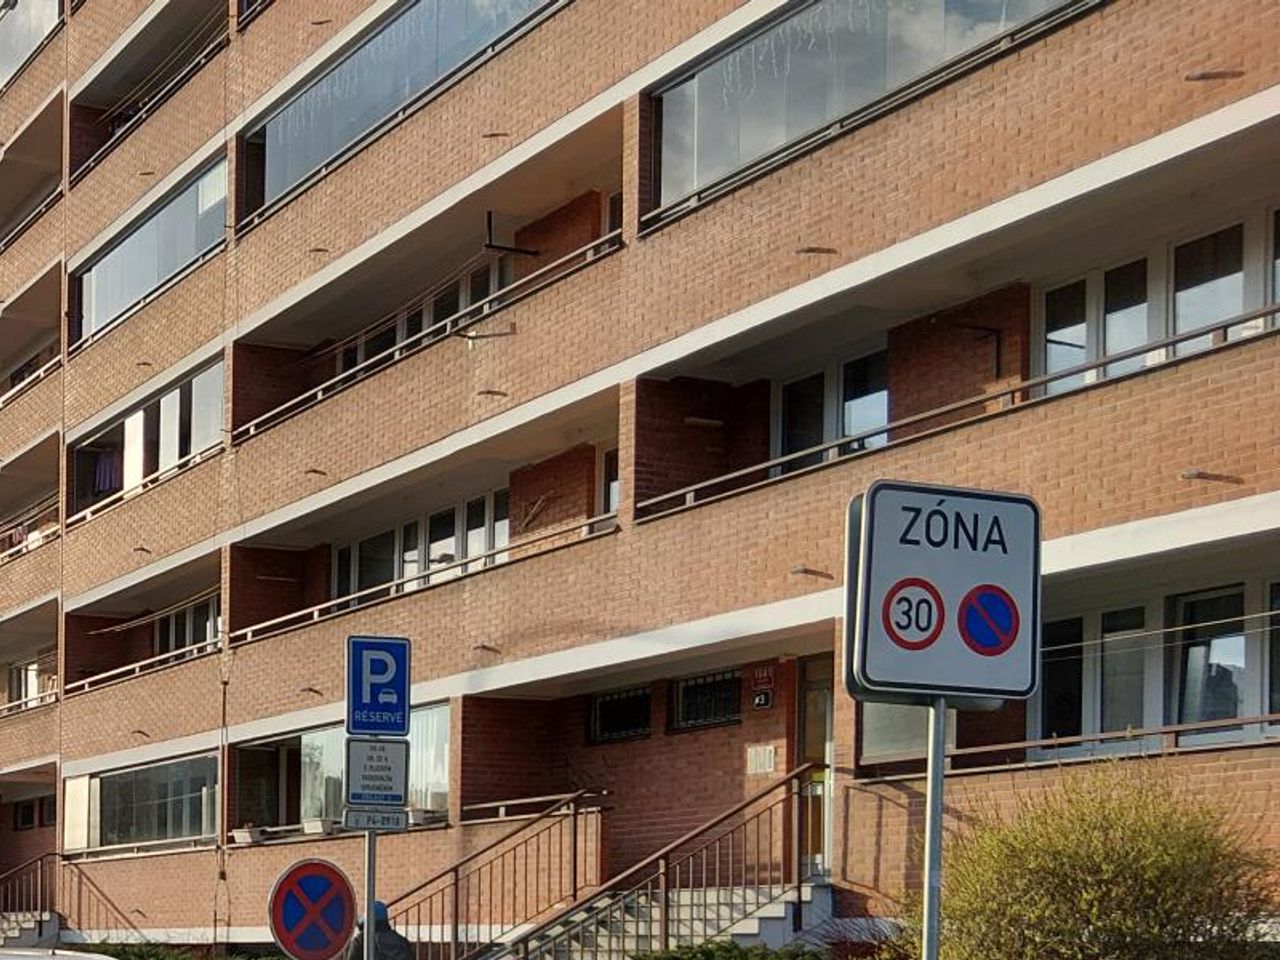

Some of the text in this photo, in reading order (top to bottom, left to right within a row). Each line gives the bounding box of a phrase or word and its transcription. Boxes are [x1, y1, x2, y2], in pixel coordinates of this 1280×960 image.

[899, 499, 1008, 554] ZÓNA
[895, 596, 933, 632] 30
[362, 650, 396, 703] P
